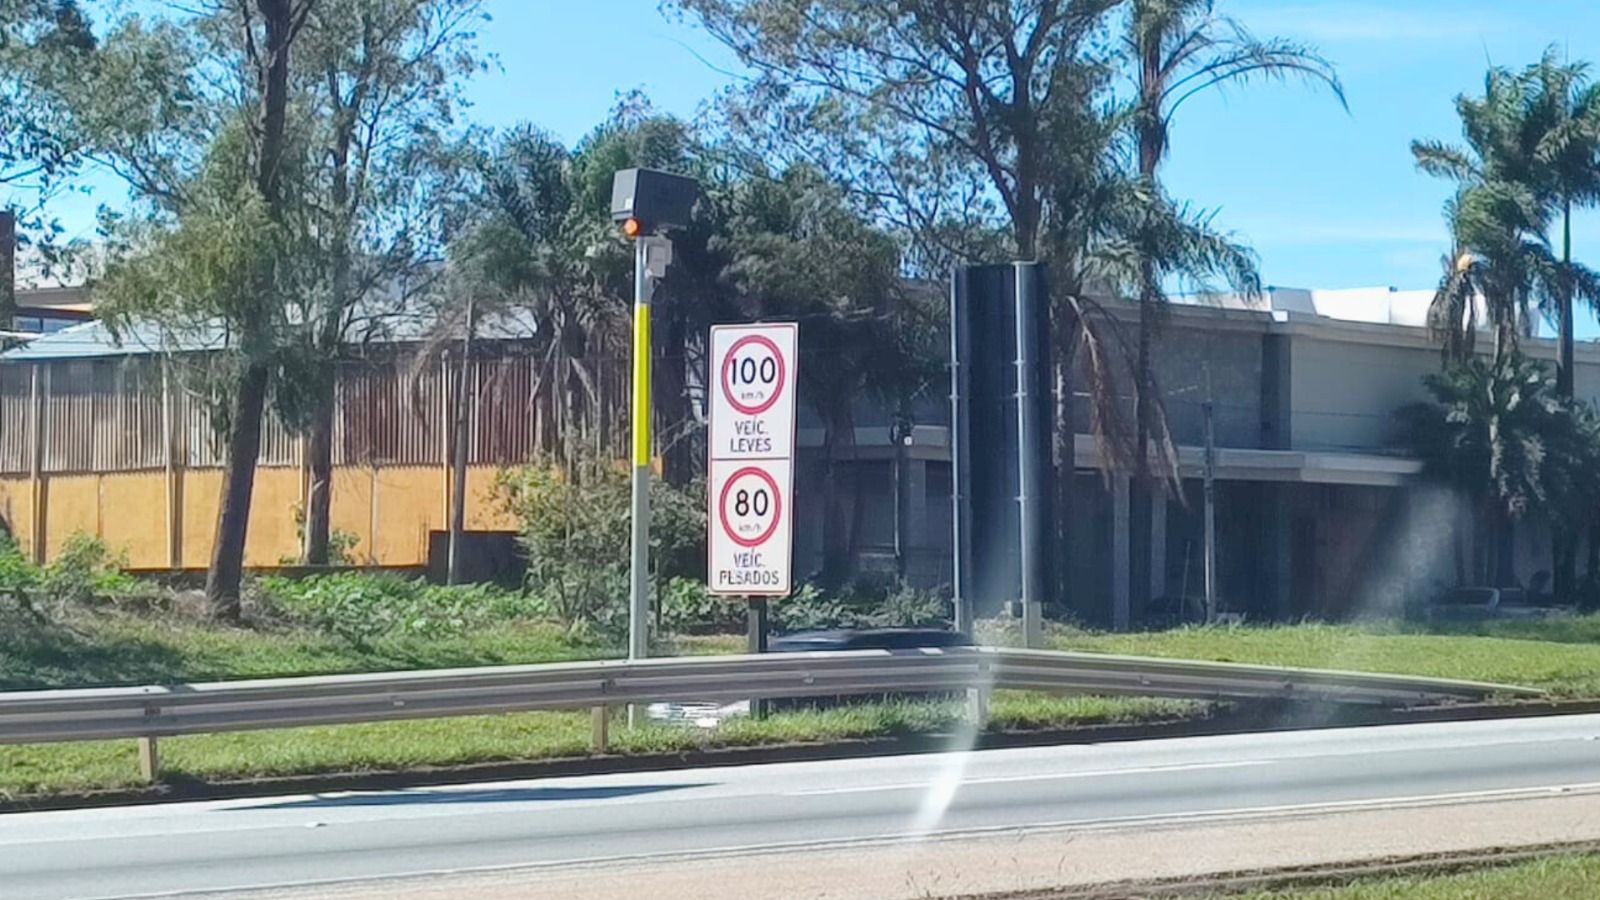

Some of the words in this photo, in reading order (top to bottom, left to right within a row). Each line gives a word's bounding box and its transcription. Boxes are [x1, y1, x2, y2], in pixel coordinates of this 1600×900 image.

[731, 357, 776, 386] 100
[730, 438, 772, 453] LEVES
[735, 489, 768, 517] 80
